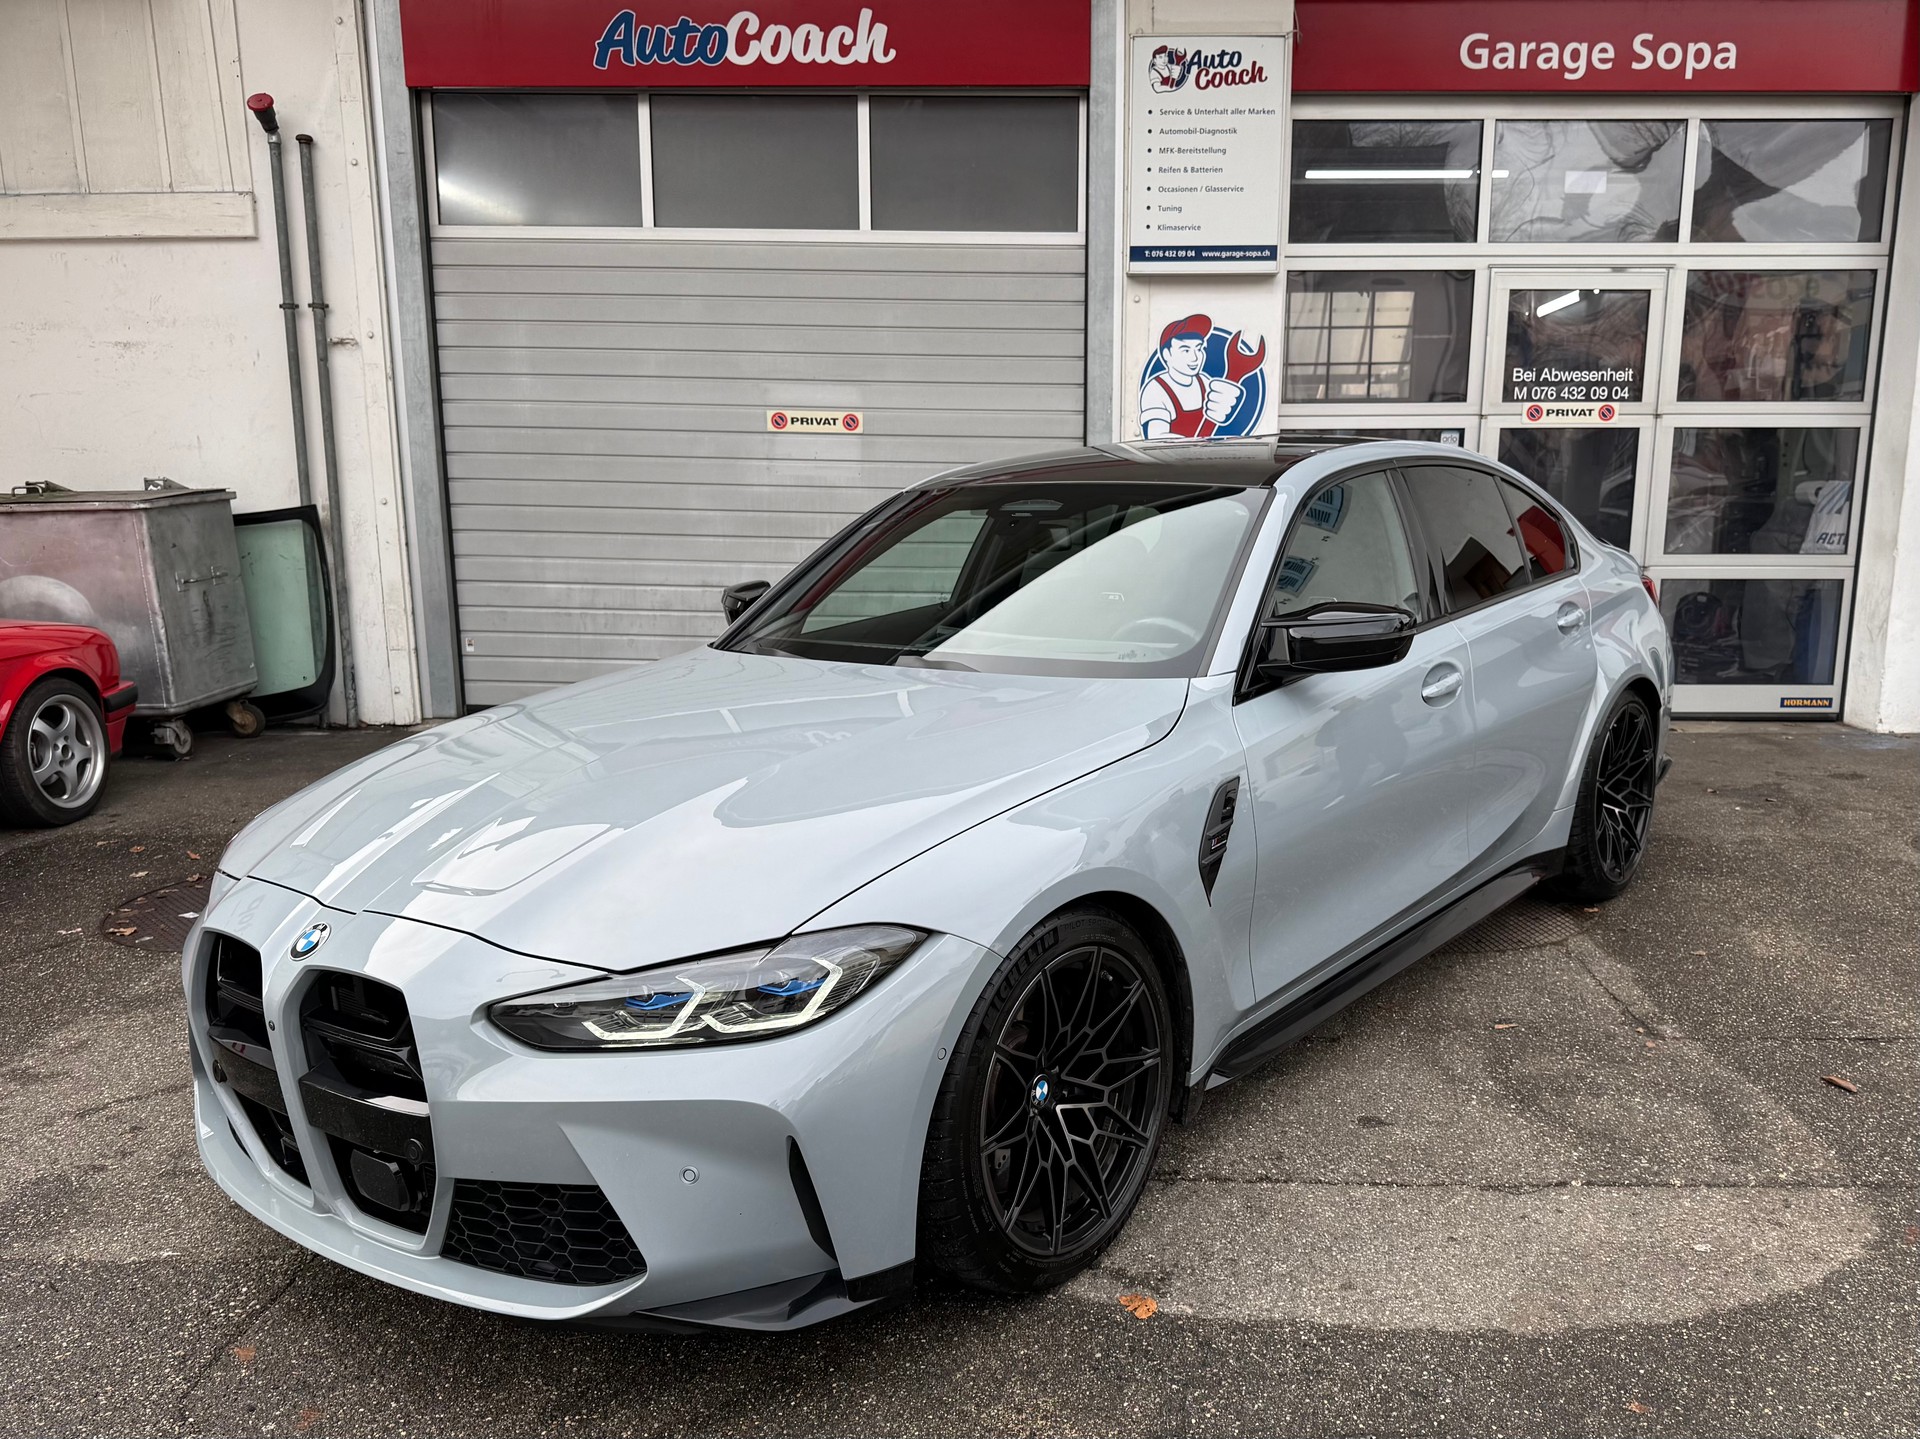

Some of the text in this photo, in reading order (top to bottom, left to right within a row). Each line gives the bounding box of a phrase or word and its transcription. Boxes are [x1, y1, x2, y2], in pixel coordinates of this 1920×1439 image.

[593, 7, 897, 70] AutoCoach
[1459, 32, 1738, 80] Garage Sopa
[1186, 49, 1243, 75] Auto
[1194, 60, 1268, 90] Coach
[1159, 107, 1276, 116] Service & Unterhalt aller Marken
[1159, 127, 1238, 137] Automobil-Diagnostik
[1158, 147, 1227, 156] MFK-Bereitstellung
[1158, 166, 1224, 174] Reifen & Batterien
[1158, 185, 1198, 193] Occasionen
[1204, 185, 1245, 193] Glasservice
[1157, 204, 1183, 213] Tuning
[1157, 223, 1202, 231] Klimaservice
[1151, 250, 1164, 258] 076
[1164, 250, 1177, 258] 432
[1177, 250, 1186, 258] 09
[1186, 250, 1196, 258] 04
[1201, 249, 1271, 259] www.garage-sopa.ch
[1512, 367, 1634, 382] Bei Abwesenheit
[1513, 386, 1630, 400] M 076 432 09 04
[1545, 408, 1595, 417] PRIVAT
[790, 416, 839, 426] PRIVAT
[982, 930, 1056, 1031] MICHELIN
